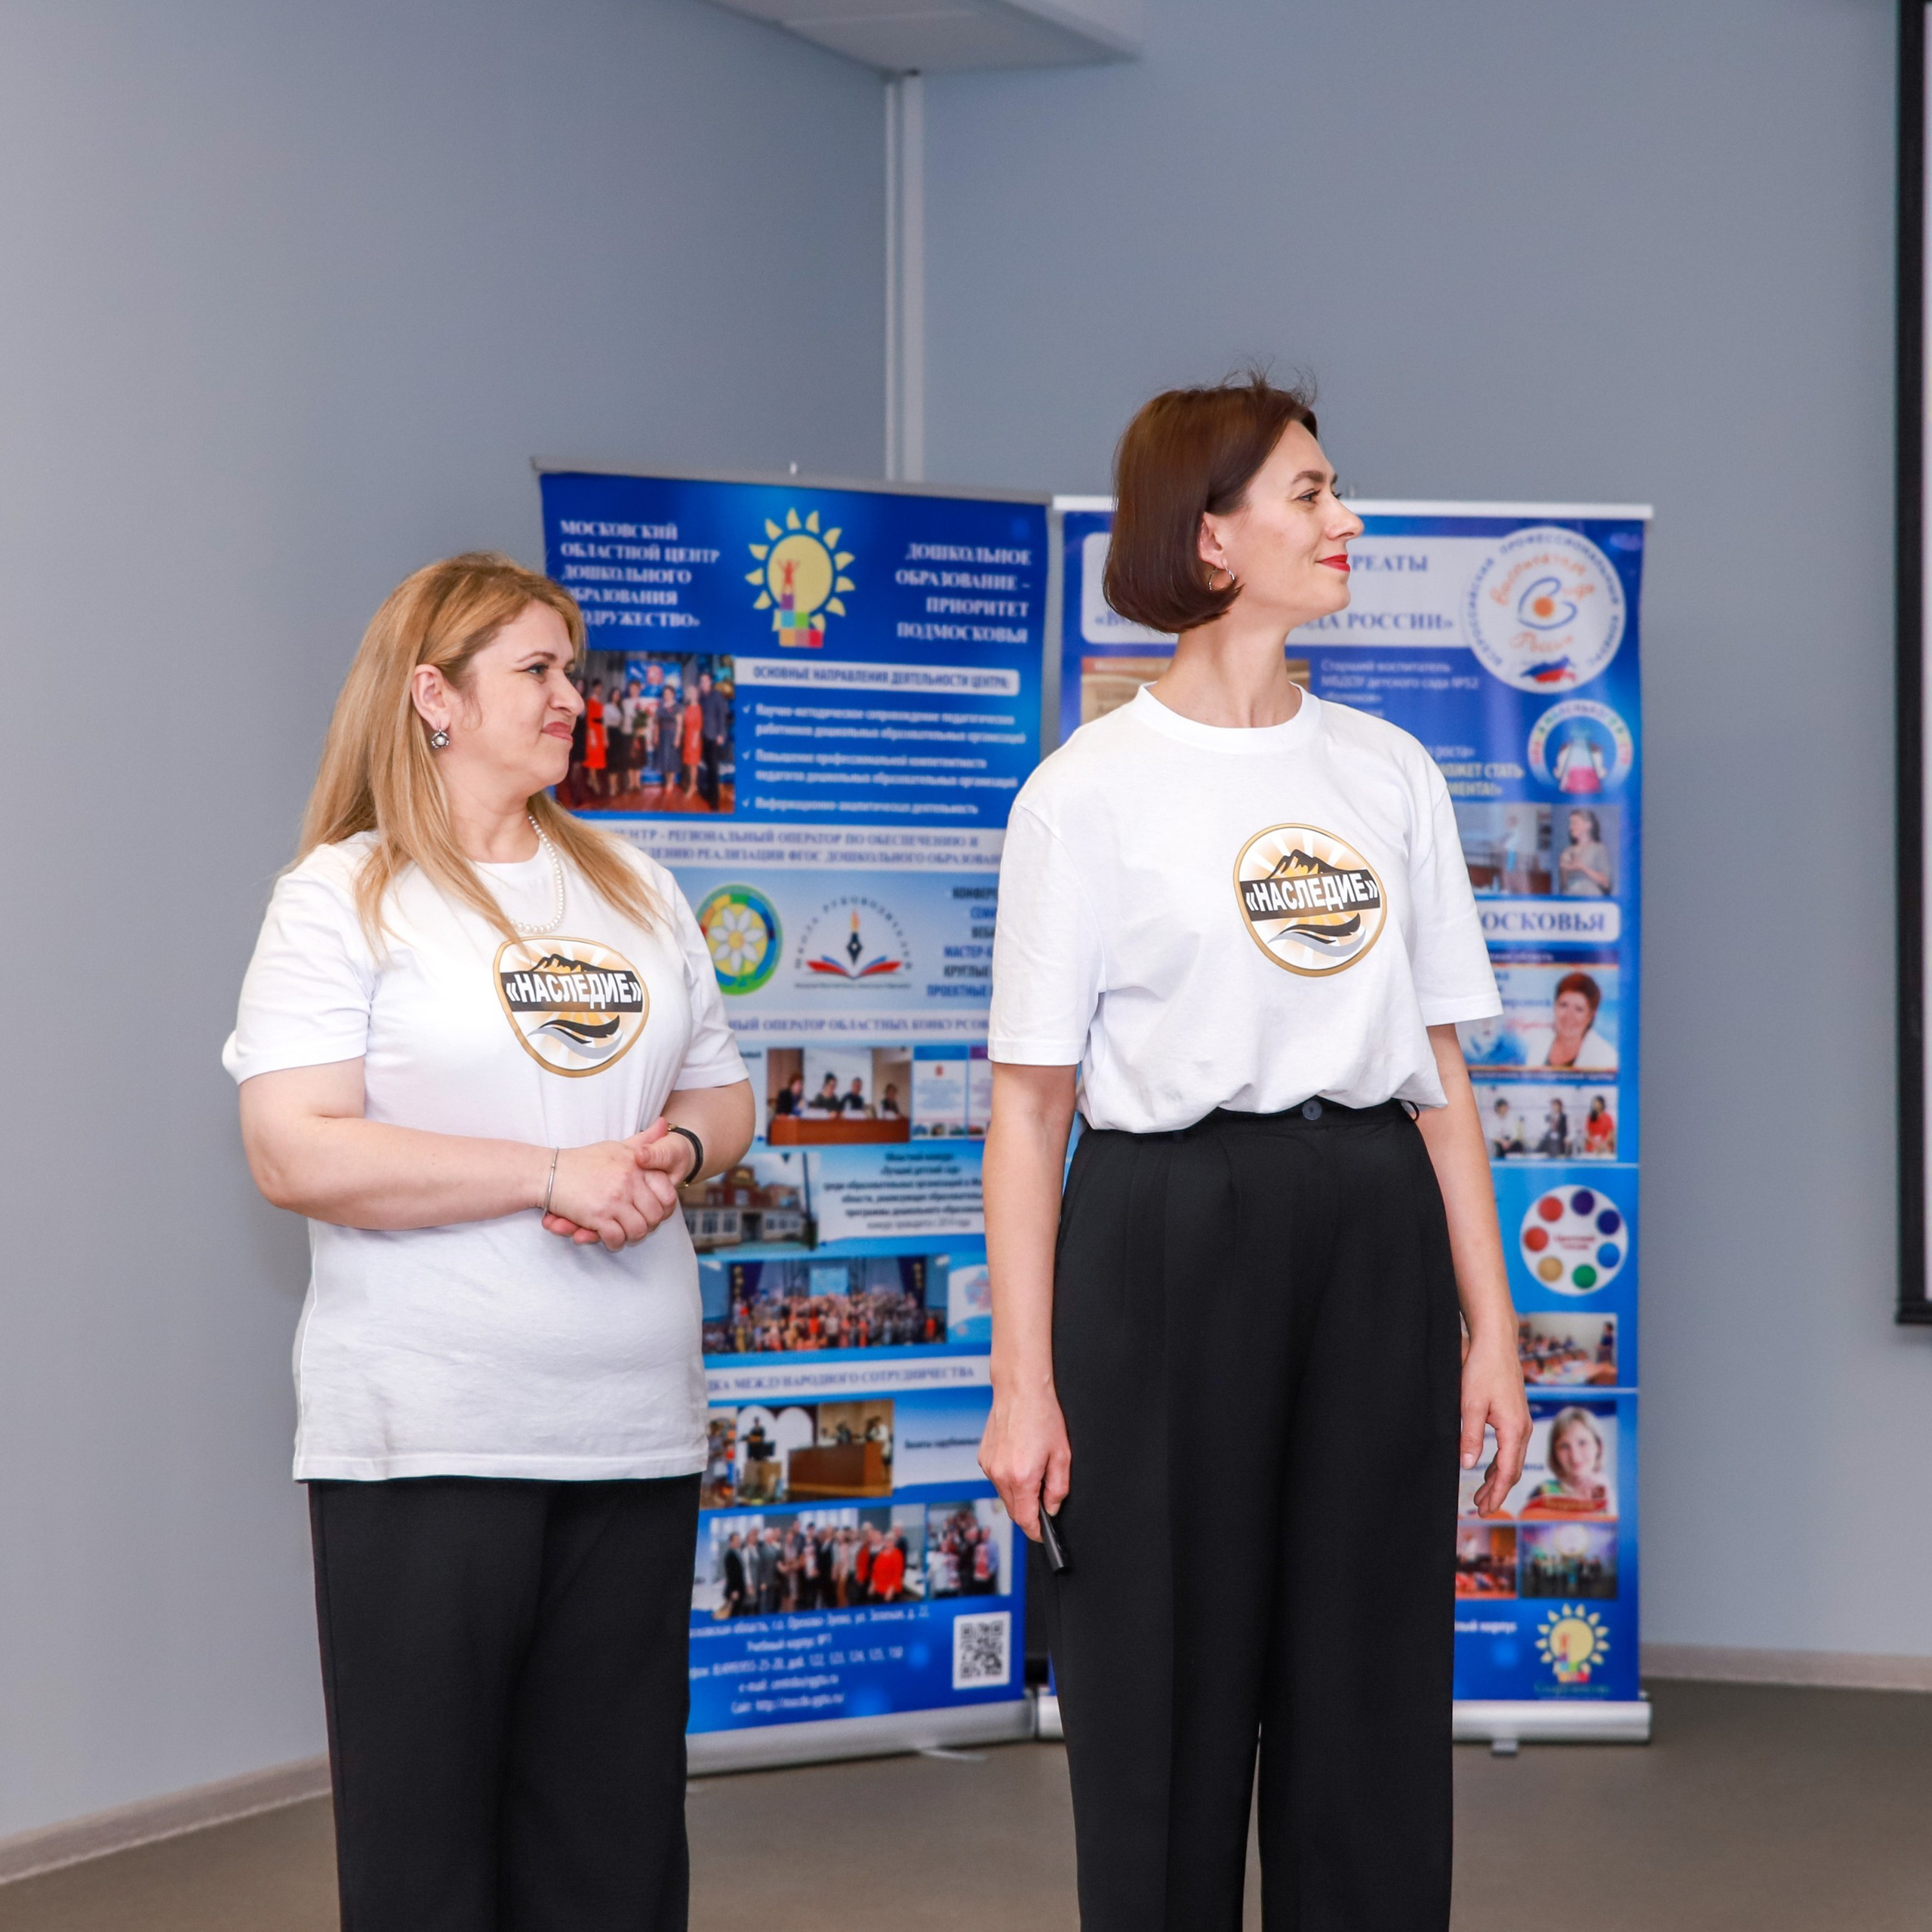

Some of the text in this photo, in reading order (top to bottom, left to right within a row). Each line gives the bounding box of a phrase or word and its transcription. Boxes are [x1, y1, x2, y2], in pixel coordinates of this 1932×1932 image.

[561, 521, 678, 540] МОСКОВСКИЙ
[560, 543, 720, 564] ОБЛАСТНОЙ ЦЕНТР
[906, 543, 1032, 566] ДОШКОЛЬНОЕ
[1352, 555, 1429, 572] РЕАТЫ
[561, 565, 692, 584] ДОШКОЛЬНОГО
[895, 569, 1018, 591] ОБРАЗОВАНИЕ
[926, 596, 1029, 617] ПРИОРИТЕТ
[897, 622, 1029, 643] ПОДМОСКОВЬЯ
[754, 666, 809, 679] ОСНОВНЫЕ
[813, 669, 889, 683] НАПРАВЛЕНИЯ
[891, 672, 968, 686] ДЕЯТЕЛЬНОСТИ
[669, 829, 775, 843] РЕГИОНАЛЬНЫЙ
[778, 832, 841, 844] ОПЕРАТОР
[845, 833, 864, 845] ПО
[868, 834, 966, 847] ОБЕСПЕЧЕНИЮ
[697, 848, 785, 862] РЕАЛИЗАЦИИ
[788, 851, 821, 862] ФГОС
[825, 851, 924, 864] ДОШКОЛЬНОГО
[1245, 872, 1378, 912] «НАСЛЕДИЕ»
[1482, 912, 1605, 934] ОСКОВЬЯ
[506, 972, 641, 1010] «НАСЛЕДИЕ»
[763, 1018, 826, 1030] ОПЕРАТОР
[829, 1019, 907, 1030] ОБЛАСТНЫХ
[734, 1372, 859, 1390] МЕЖДУНАРОДНОГО
[862, 1365, 974, 1383] СОТРУДНИЧЕСТВА
